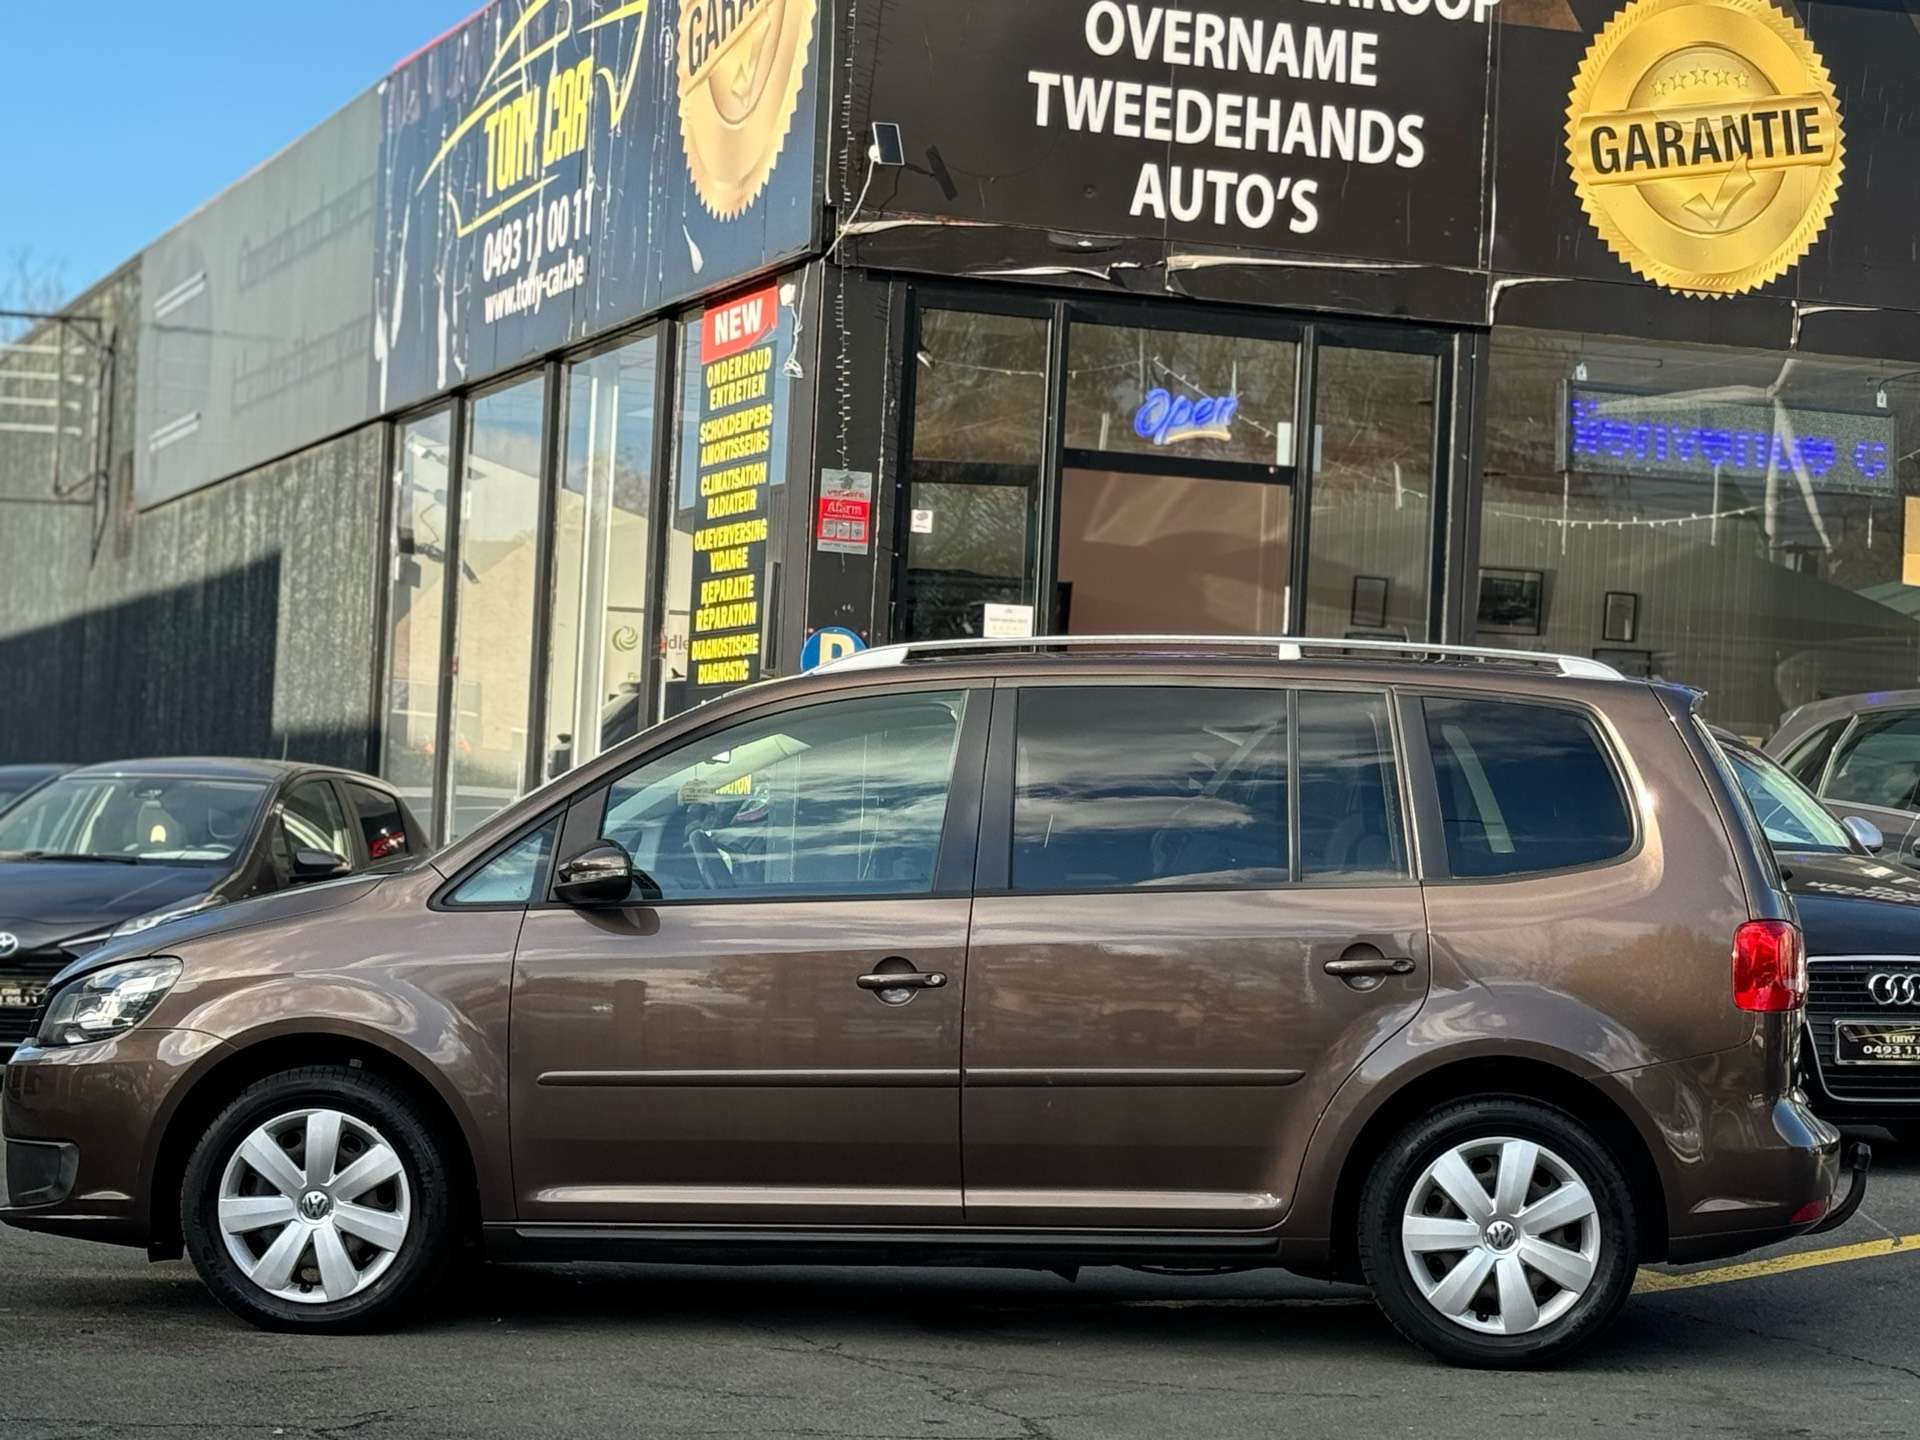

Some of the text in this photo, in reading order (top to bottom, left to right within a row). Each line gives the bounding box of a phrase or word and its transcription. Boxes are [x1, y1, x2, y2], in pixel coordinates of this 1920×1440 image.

[1085, 0, 1378, 87] OVERNAME
[484, 54, 594, 198] TONY CAR
[1027, 70, 1425, 169] TWEEDEHANDS
[1590, 106, 1824, 175] GARANTIE
[1129, 163, 1319, 234] AUTO'S
[483, 186, 594, 283] 0493 11 00 11
[485, 248, 584, 324] www.tony-car.be
[714, 298, 763, 347] NEW
[706, 346, 772, 389] ONDERHOUD
[709, 371, 766, 412] ENTRETIEN
[699, 402, 773, 444] SCHOKDEMPERS
[1134, 387, 1238, 446] Open
[700, 429, 770, 468] AMORTISSEURS
[701, 460, 768, 497] CLIMATISATION
[706, 488, 758, 520] RADIATEUR
[694, 517, 768, 552] OLIEVERVERSING
[710, 545, 750, 573] VIDANGE
[700, 573, 756, 606] REPARATIE
[695, 601, 758, 632] RÉPARATION
[691, 632, 760, 661] DIAGNOSTISCHE
[697, 658, 751, 685] DIAGNOSTIC
[1863, 1044, 1901, 1055] 0493
